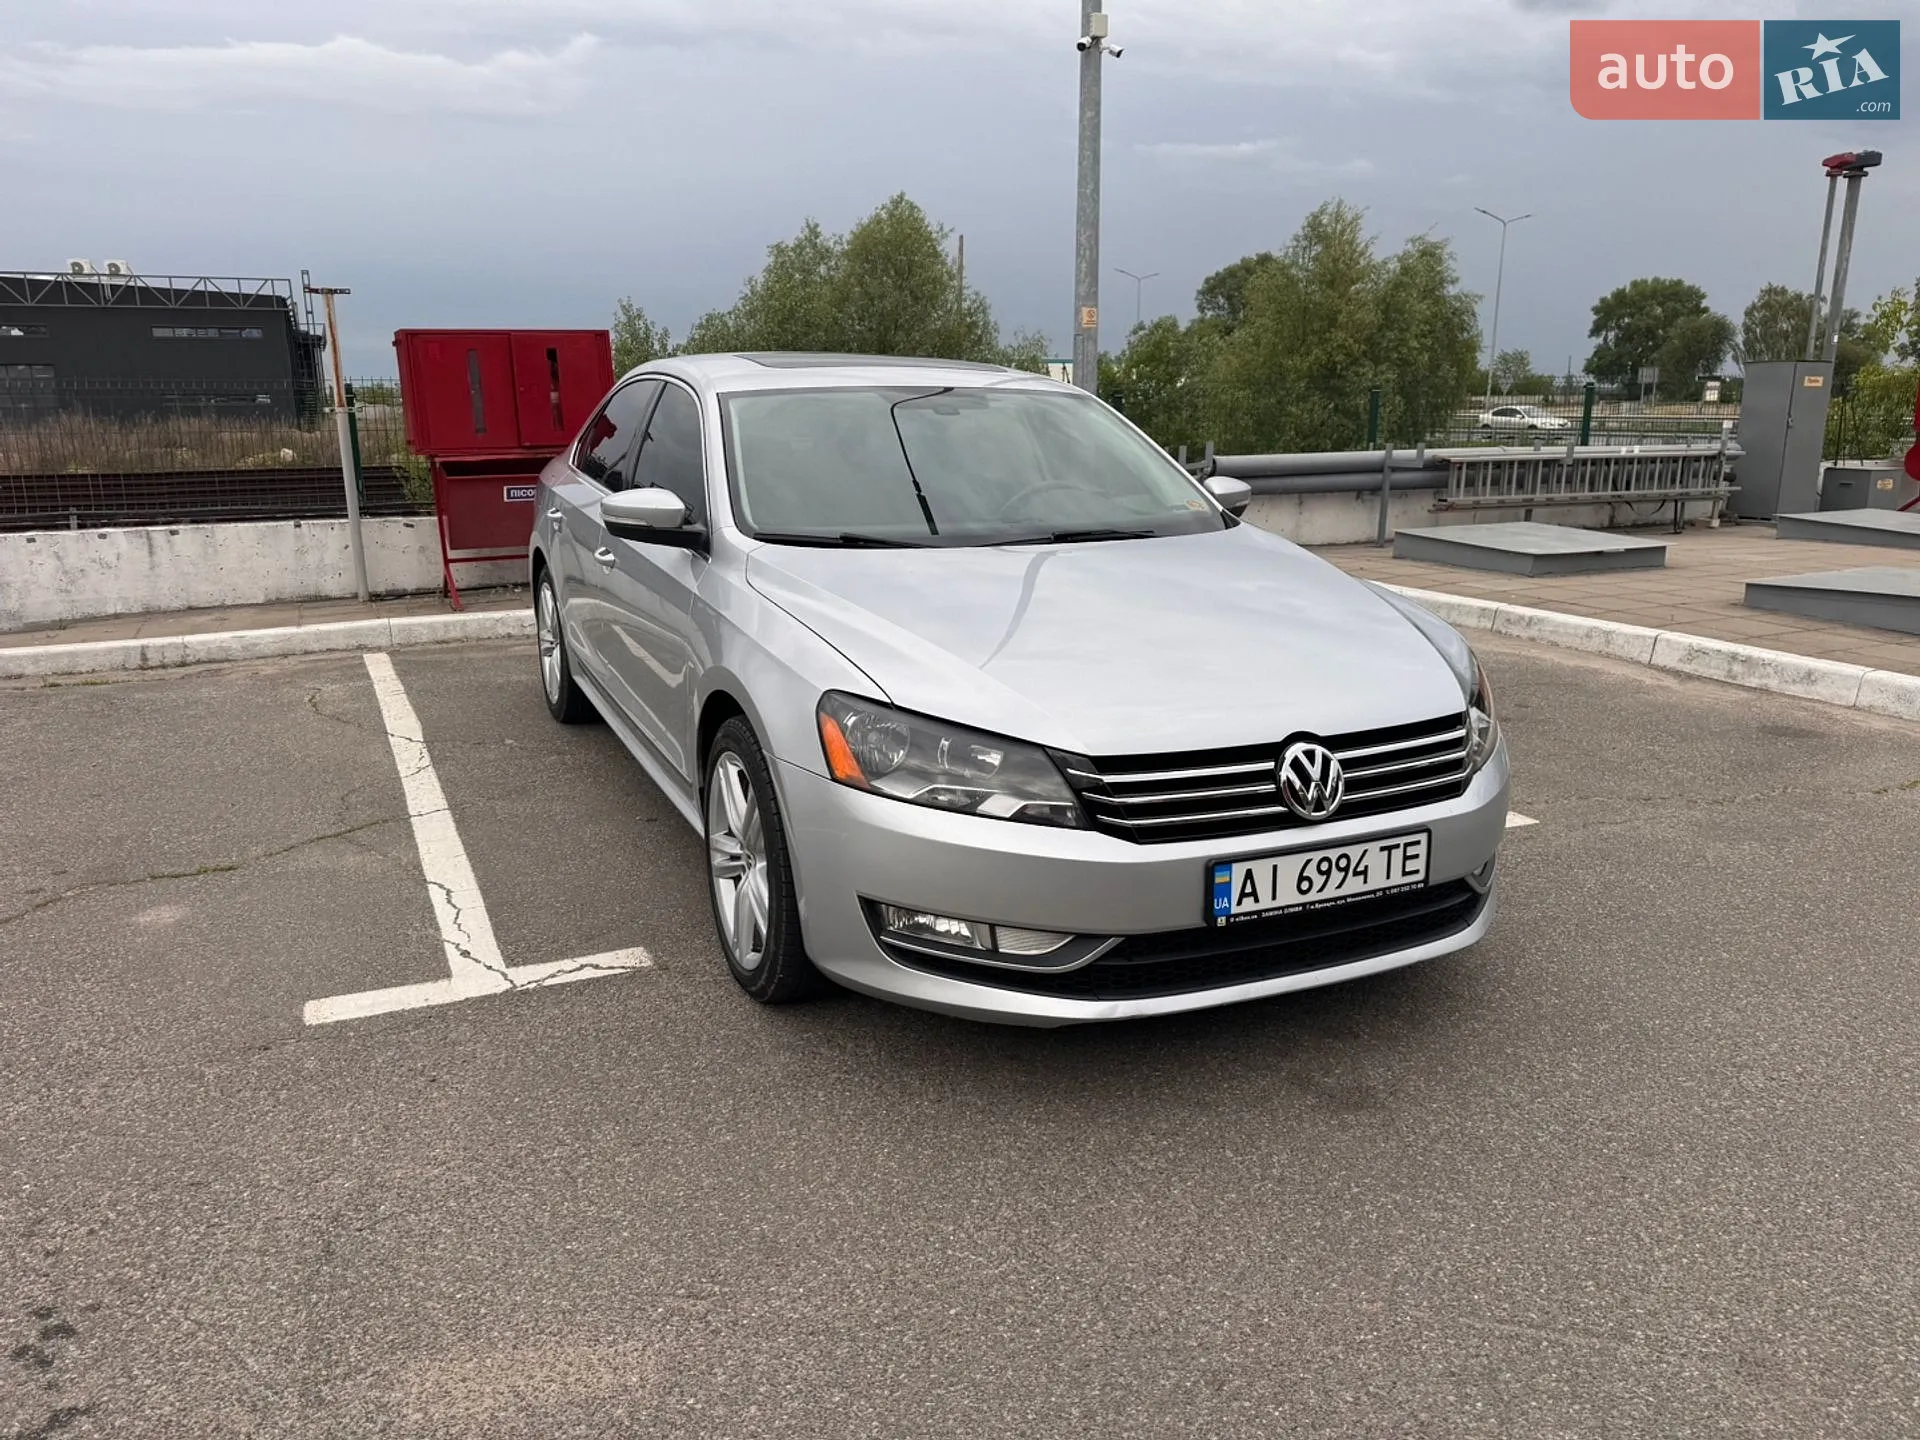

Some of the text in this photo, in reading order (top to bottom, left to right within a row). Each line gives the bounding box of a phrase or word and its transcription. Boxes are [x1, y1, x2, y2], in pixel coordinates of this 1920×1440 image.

[510, 489, 535, 498] ПІСО
[1236, 864, 1279, 906] AI
[1296, 848, 1369, 895] 6994
[1380, 840, 1421, 880] TE
[1214, 896, 1229, 909] UA
